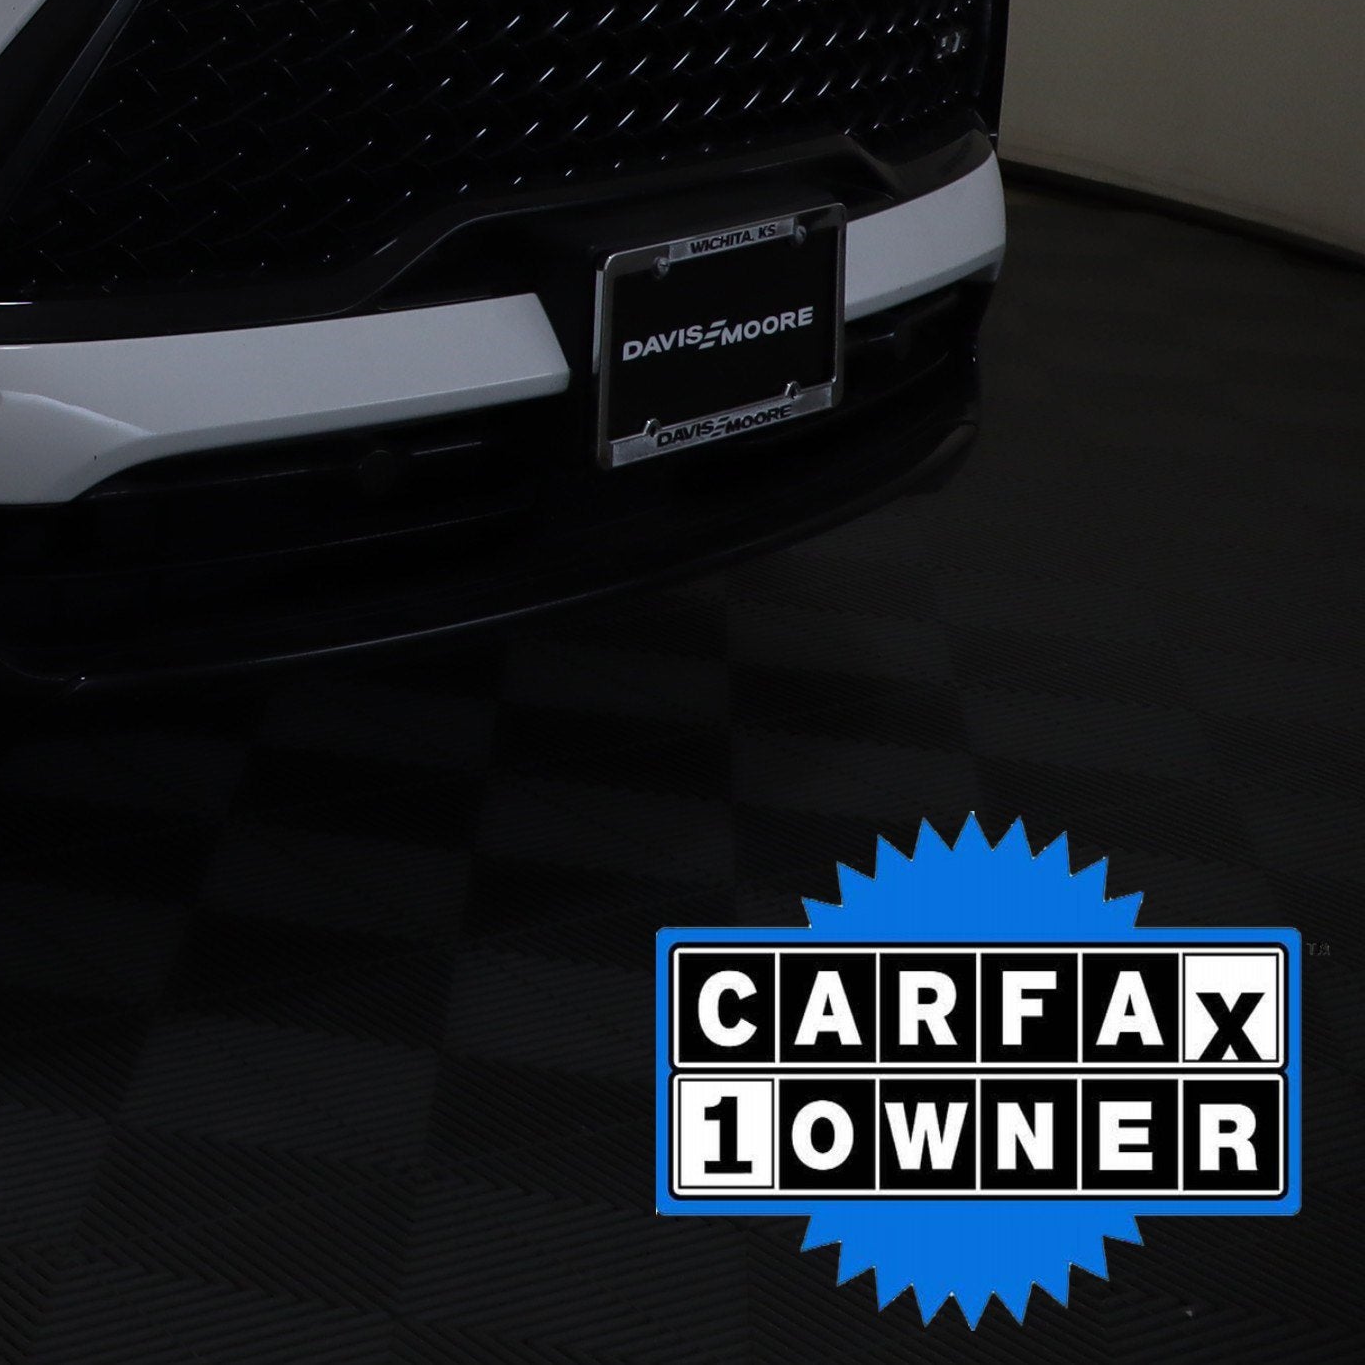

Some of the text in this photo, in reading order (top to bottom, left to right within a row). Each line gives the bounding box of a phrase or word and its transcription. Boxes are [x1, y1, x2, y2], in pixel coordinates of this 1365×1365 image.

[758, 224, 776, 238] KS
[622, 306, 814, 362] DAVIS MOORE
